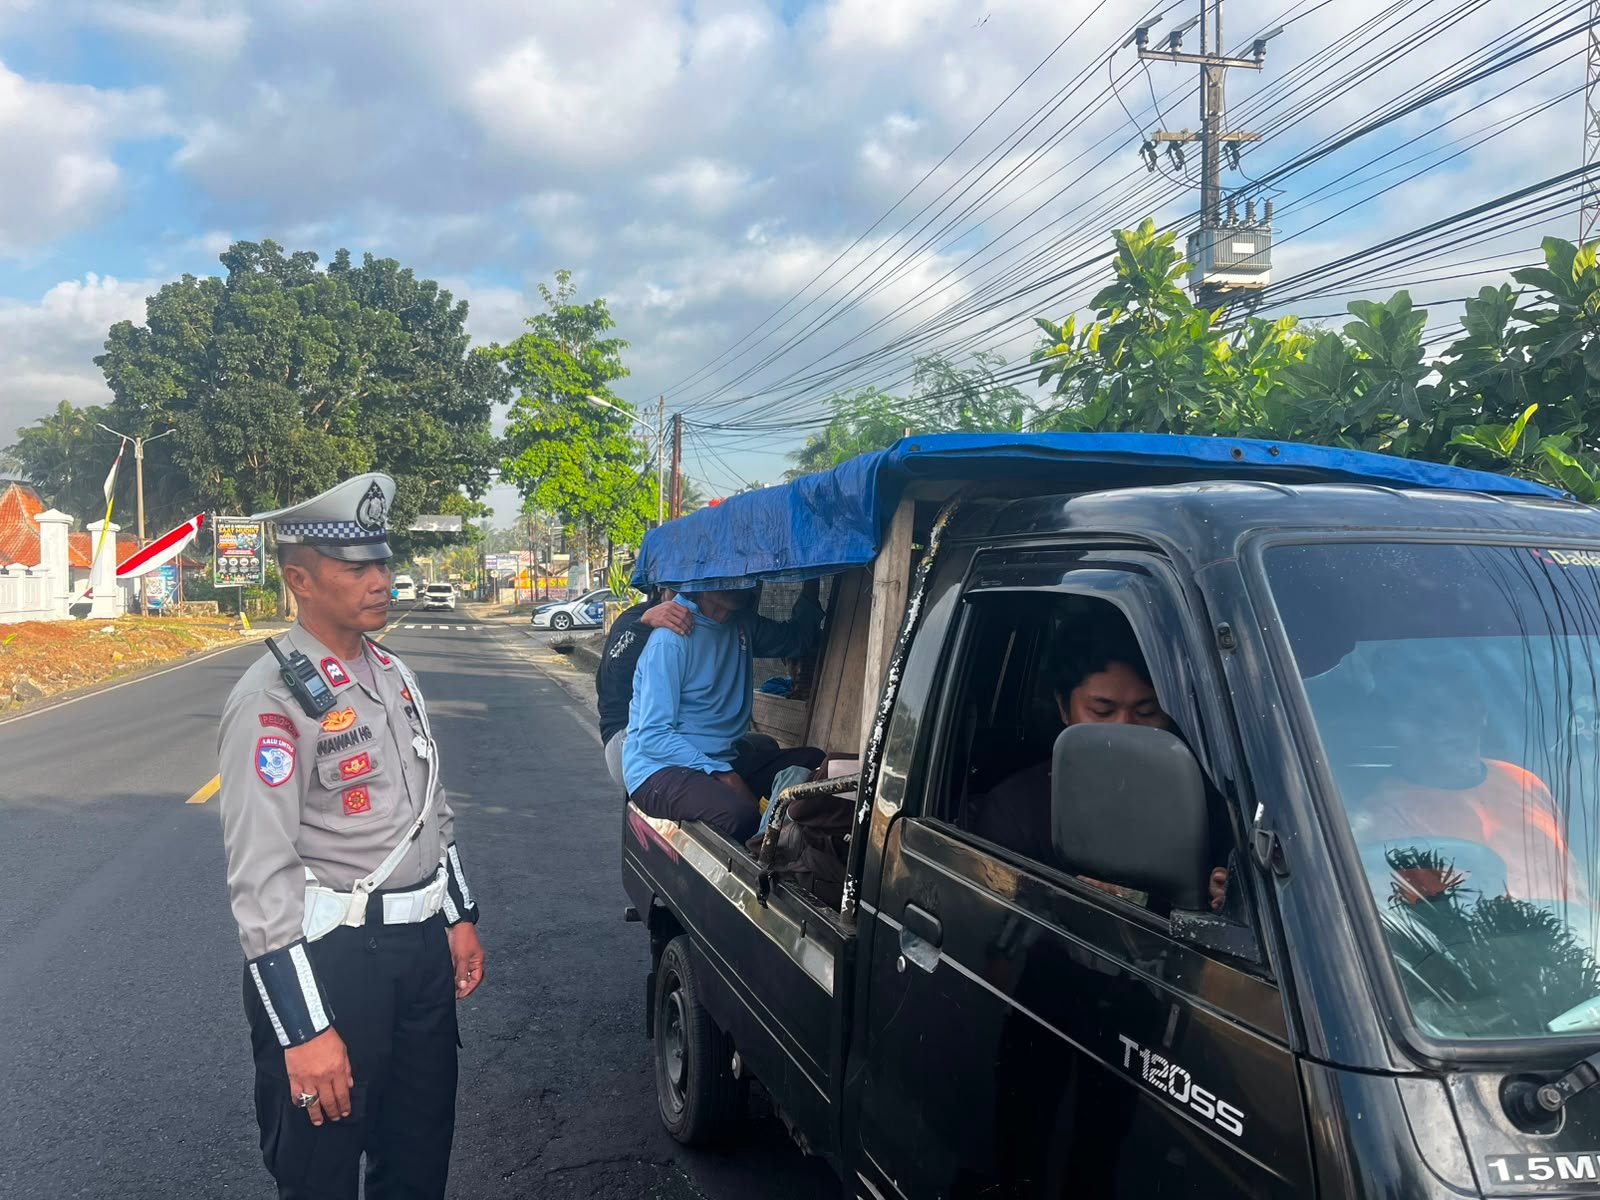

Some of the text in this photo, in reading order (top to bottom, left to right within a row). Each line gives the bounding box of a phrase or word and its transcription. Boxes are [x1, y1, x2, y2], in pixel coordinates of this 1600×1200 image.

[316, 729, 360, 756] WAWAN
[1119, 1033, 1245, 1137] T120SS
[1487, 1155, 1600, 1181] 1.5M
